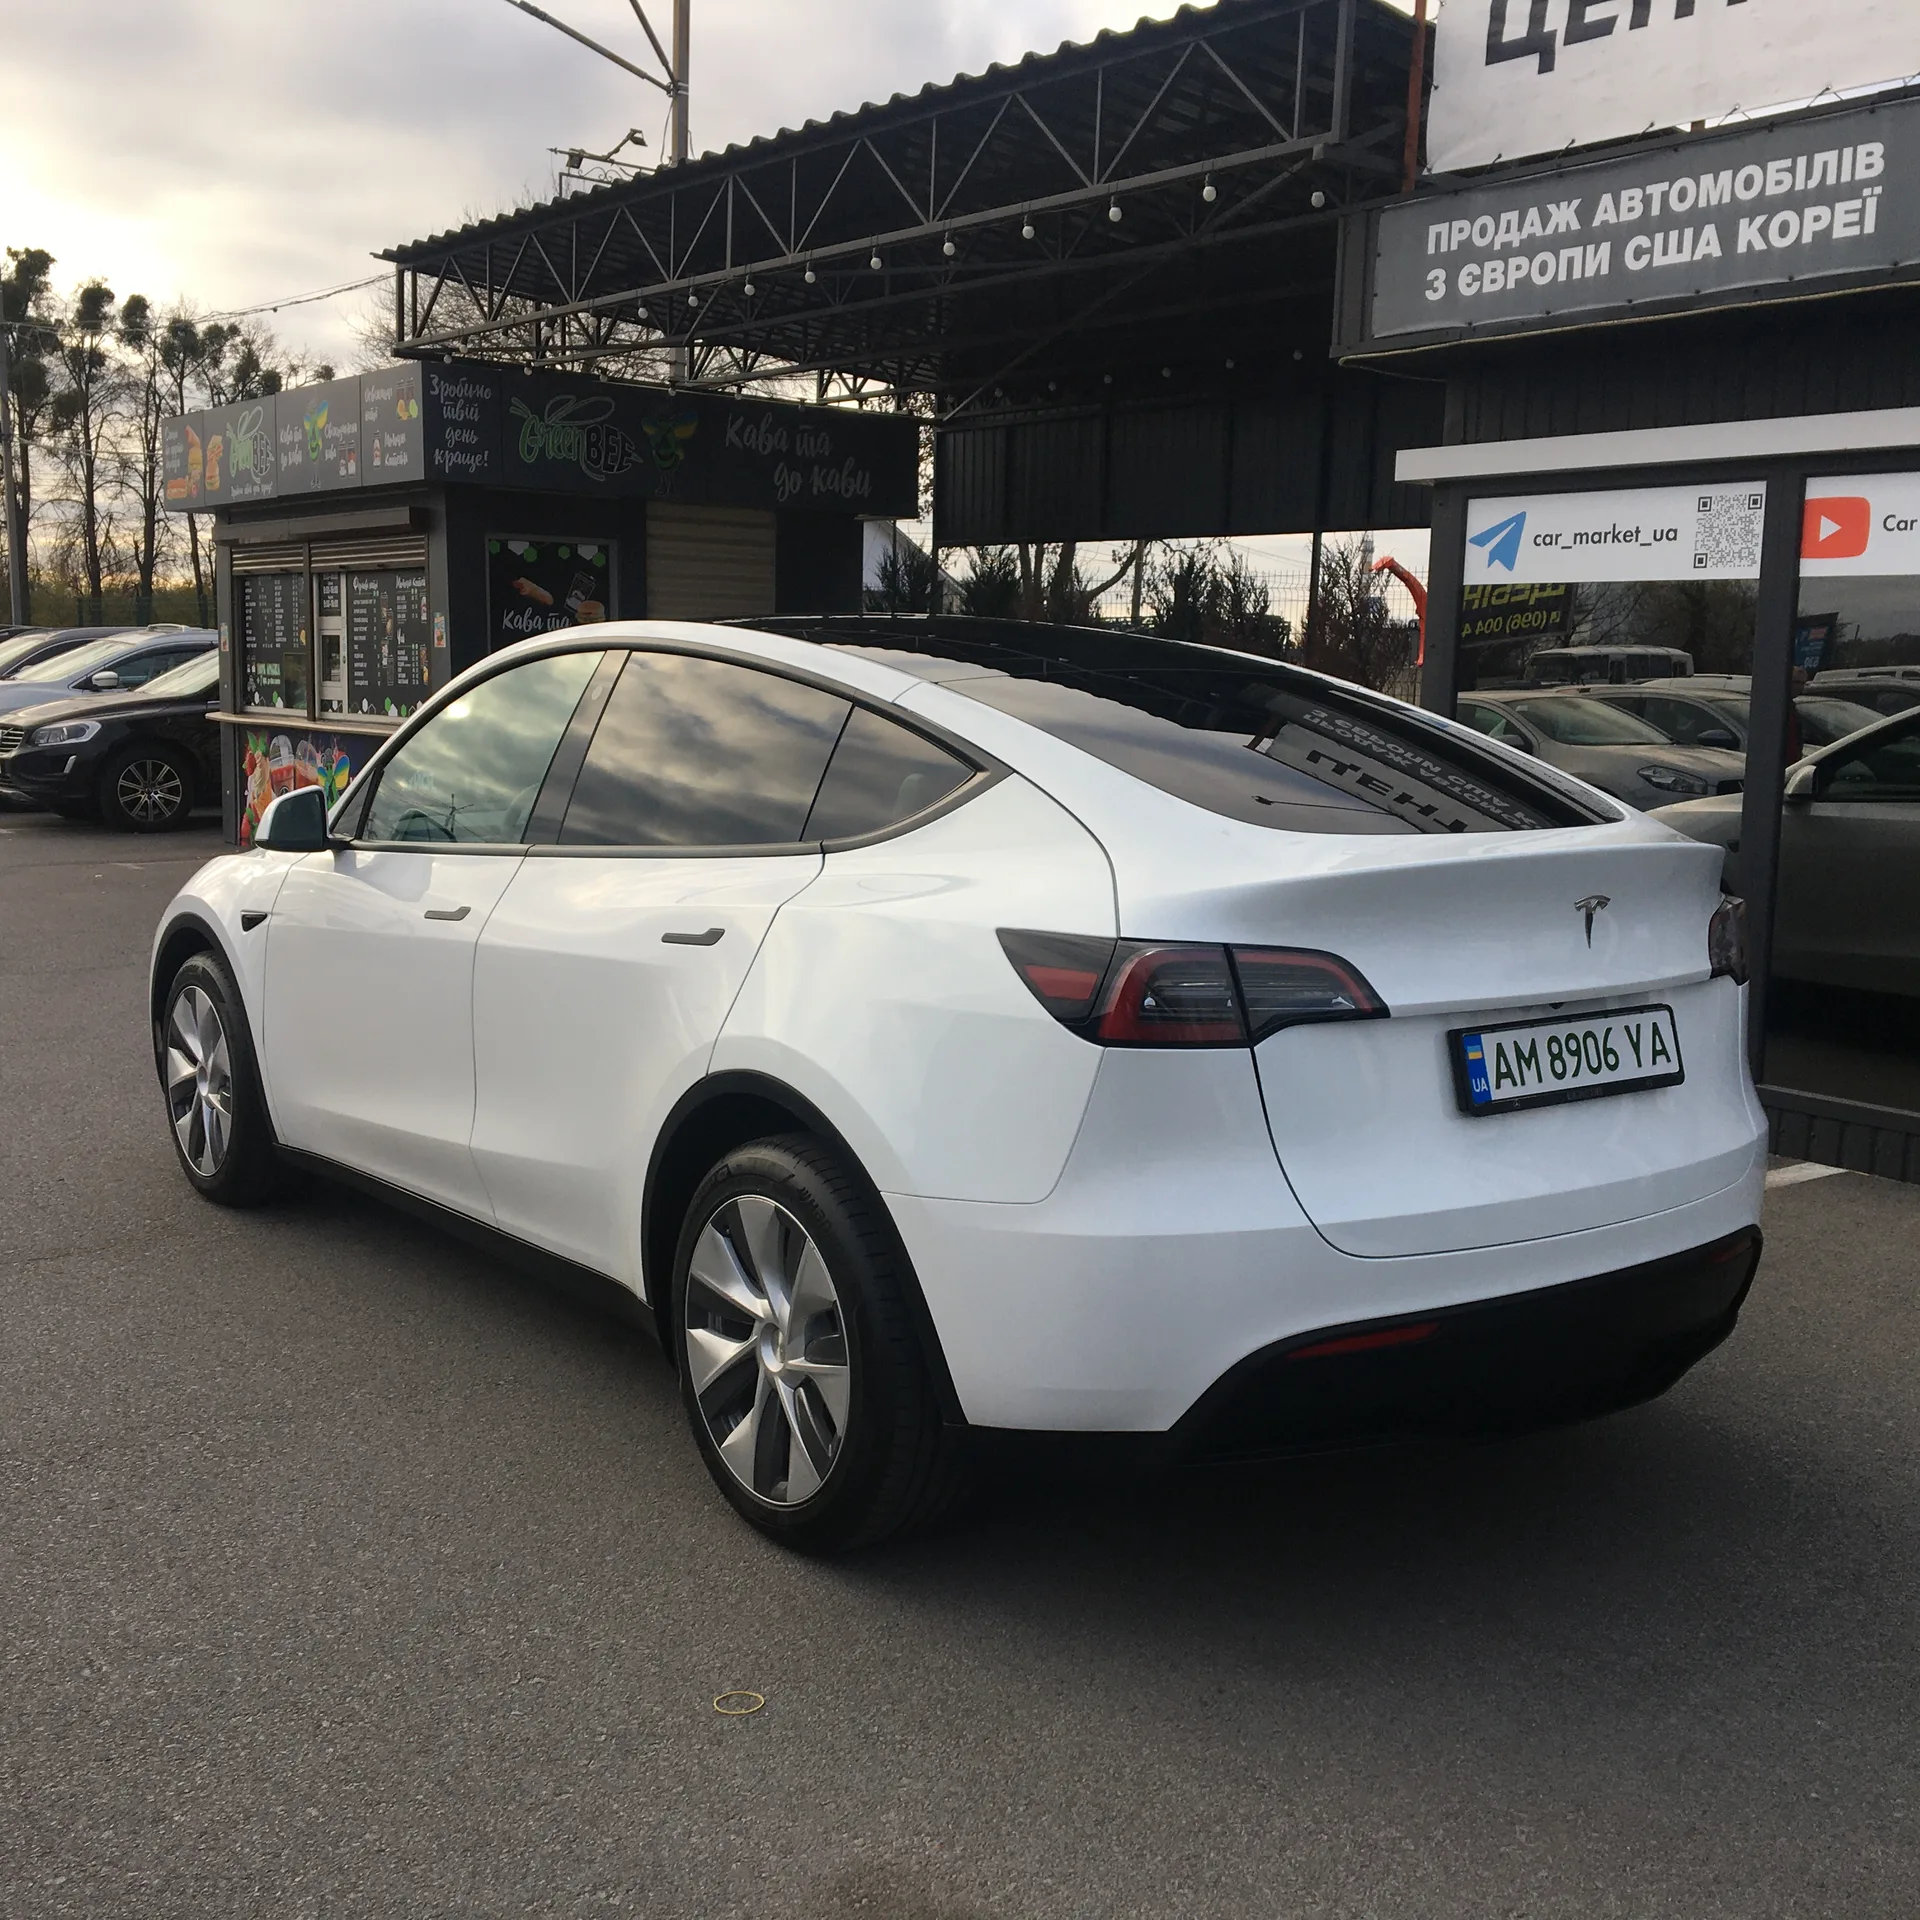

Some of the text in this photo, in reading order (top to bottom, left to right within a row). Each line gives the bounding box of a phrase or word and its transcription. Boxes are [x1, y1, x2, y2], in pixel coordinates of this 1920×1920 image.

[1427, 141, 1885, 255] ПРОДАЖ АВТОМОБІЛІВ
[1424, 185, 1882, 302] З ЄВРОПИ США КОРЕЇ
[442, 398, 481, 422] твій
[445, 426, 479, 448] день
[725, 411, 831, 458] Кава та
[433, 447, 489, 474] краще!
[773, 456, 873, 502] до кави
[1882, 513, 1919, 532] Car
[1532, 523, 1679, 551] car_market_ua
[502, 606, 543, 632] Кава
[1494, 1021, 1672, 1090] AM 8906 YA
[1472, 1079, 1489, 1094] UA
